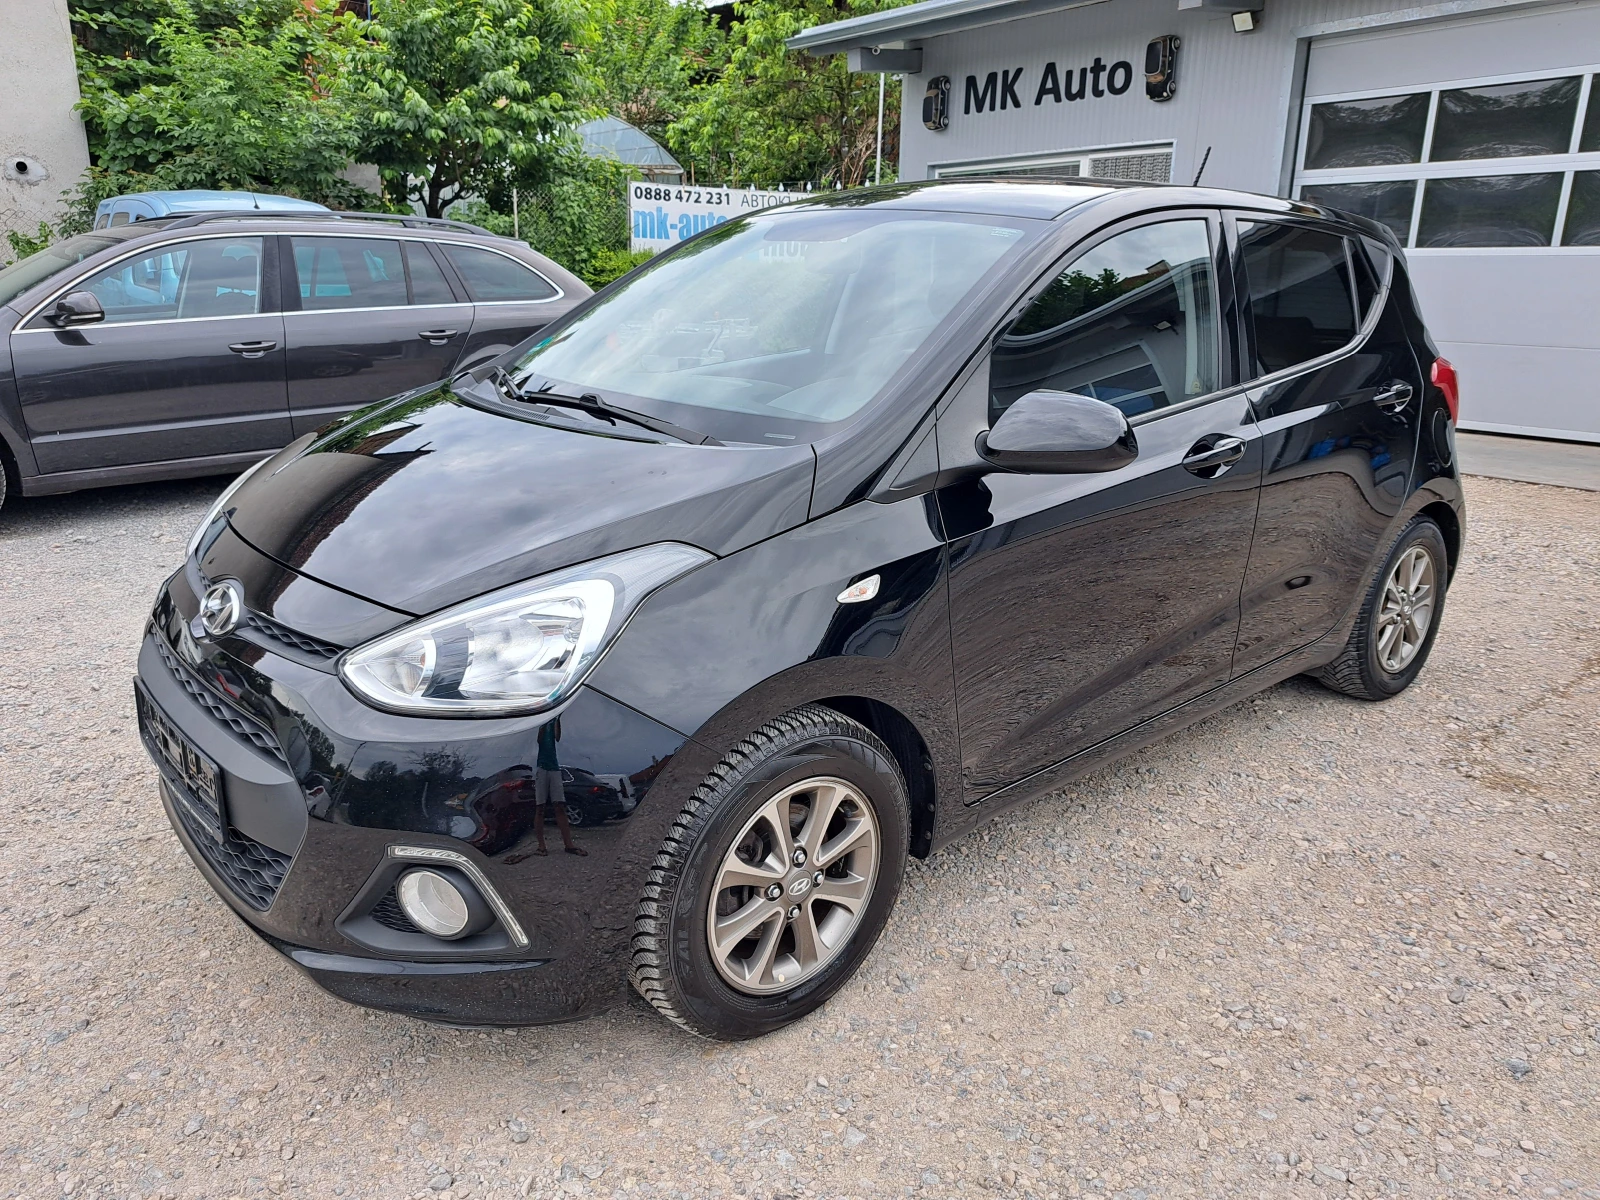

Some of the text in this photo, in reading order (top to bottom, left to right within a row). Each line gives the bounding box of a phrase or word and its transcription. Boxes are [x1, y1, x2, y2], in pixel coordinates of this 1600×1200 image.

[963, 57, 1133, 115] MK Auto
[634, 186, 731, 206] 0888 472 231
